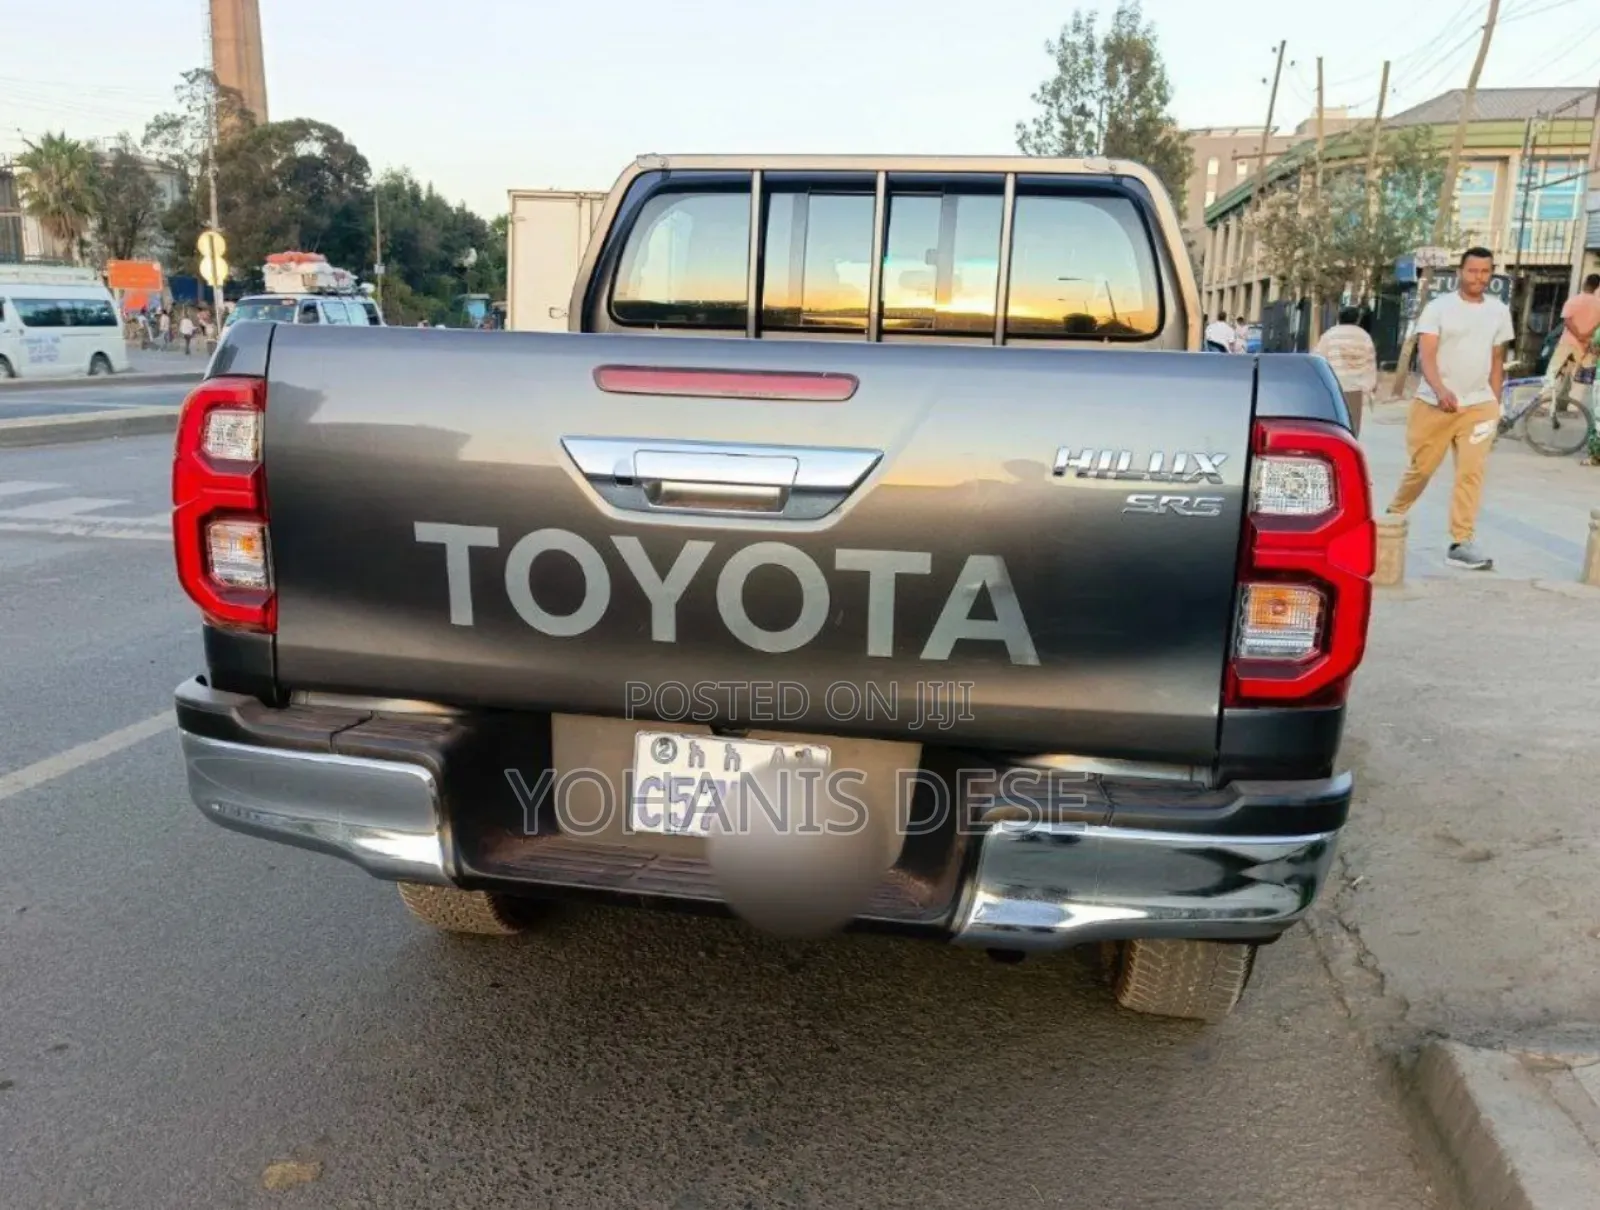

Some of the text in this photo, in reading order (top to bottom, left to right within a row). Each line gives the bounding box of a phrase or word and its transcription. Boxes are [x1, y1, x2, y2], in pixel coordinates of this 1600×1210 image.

[1052, 446, 1228, 484] HILUX
[1121, 494, 1224, 517] SR5
[413, 521, 1041, 666] TOYOTA
